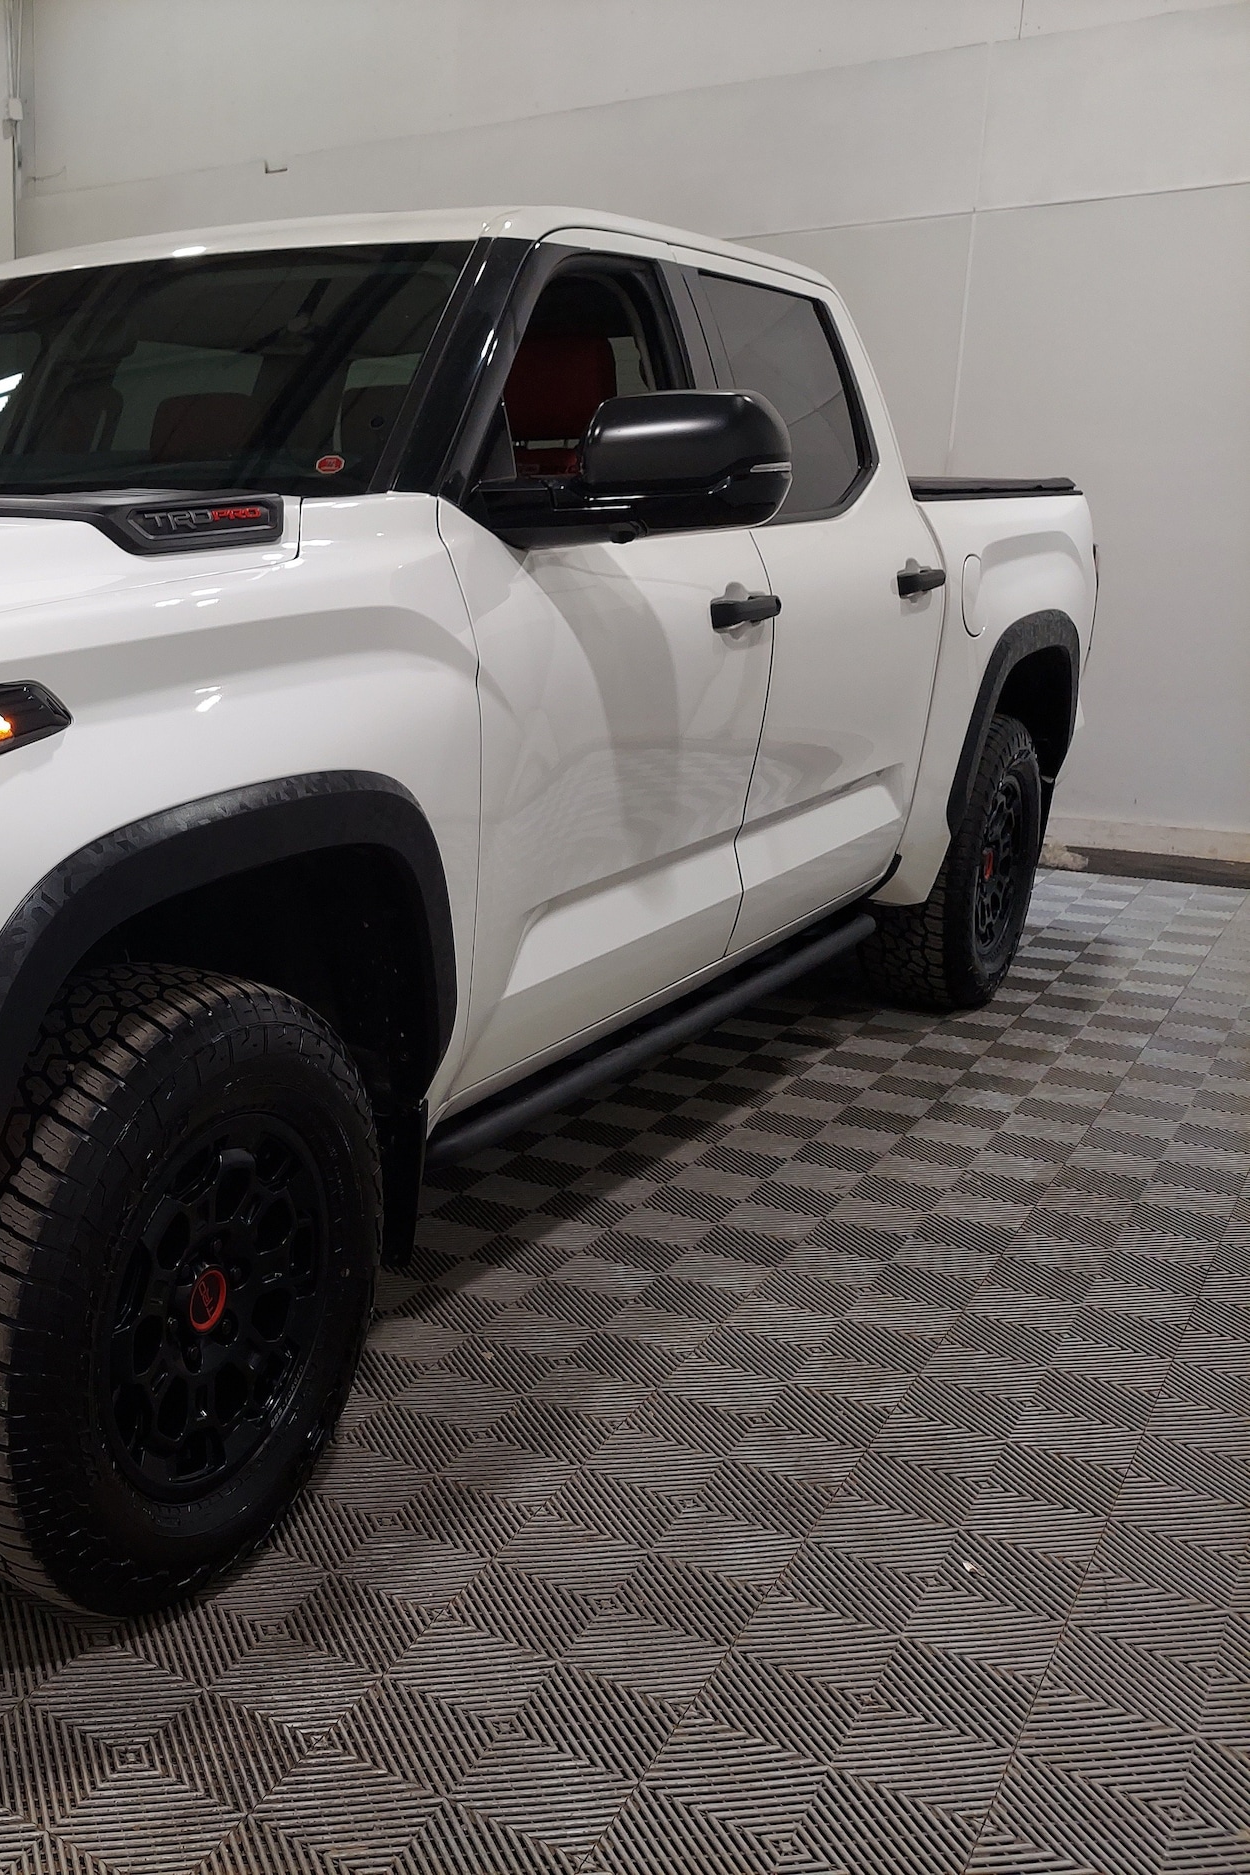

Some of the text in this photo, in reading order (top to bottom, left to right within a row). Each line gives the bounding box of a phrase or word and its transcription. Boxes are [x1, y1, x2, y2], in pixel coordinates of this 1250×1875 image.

[144, 507, 261, 530] TRD PRO
[198, 1281, 214, 1319] TRD
